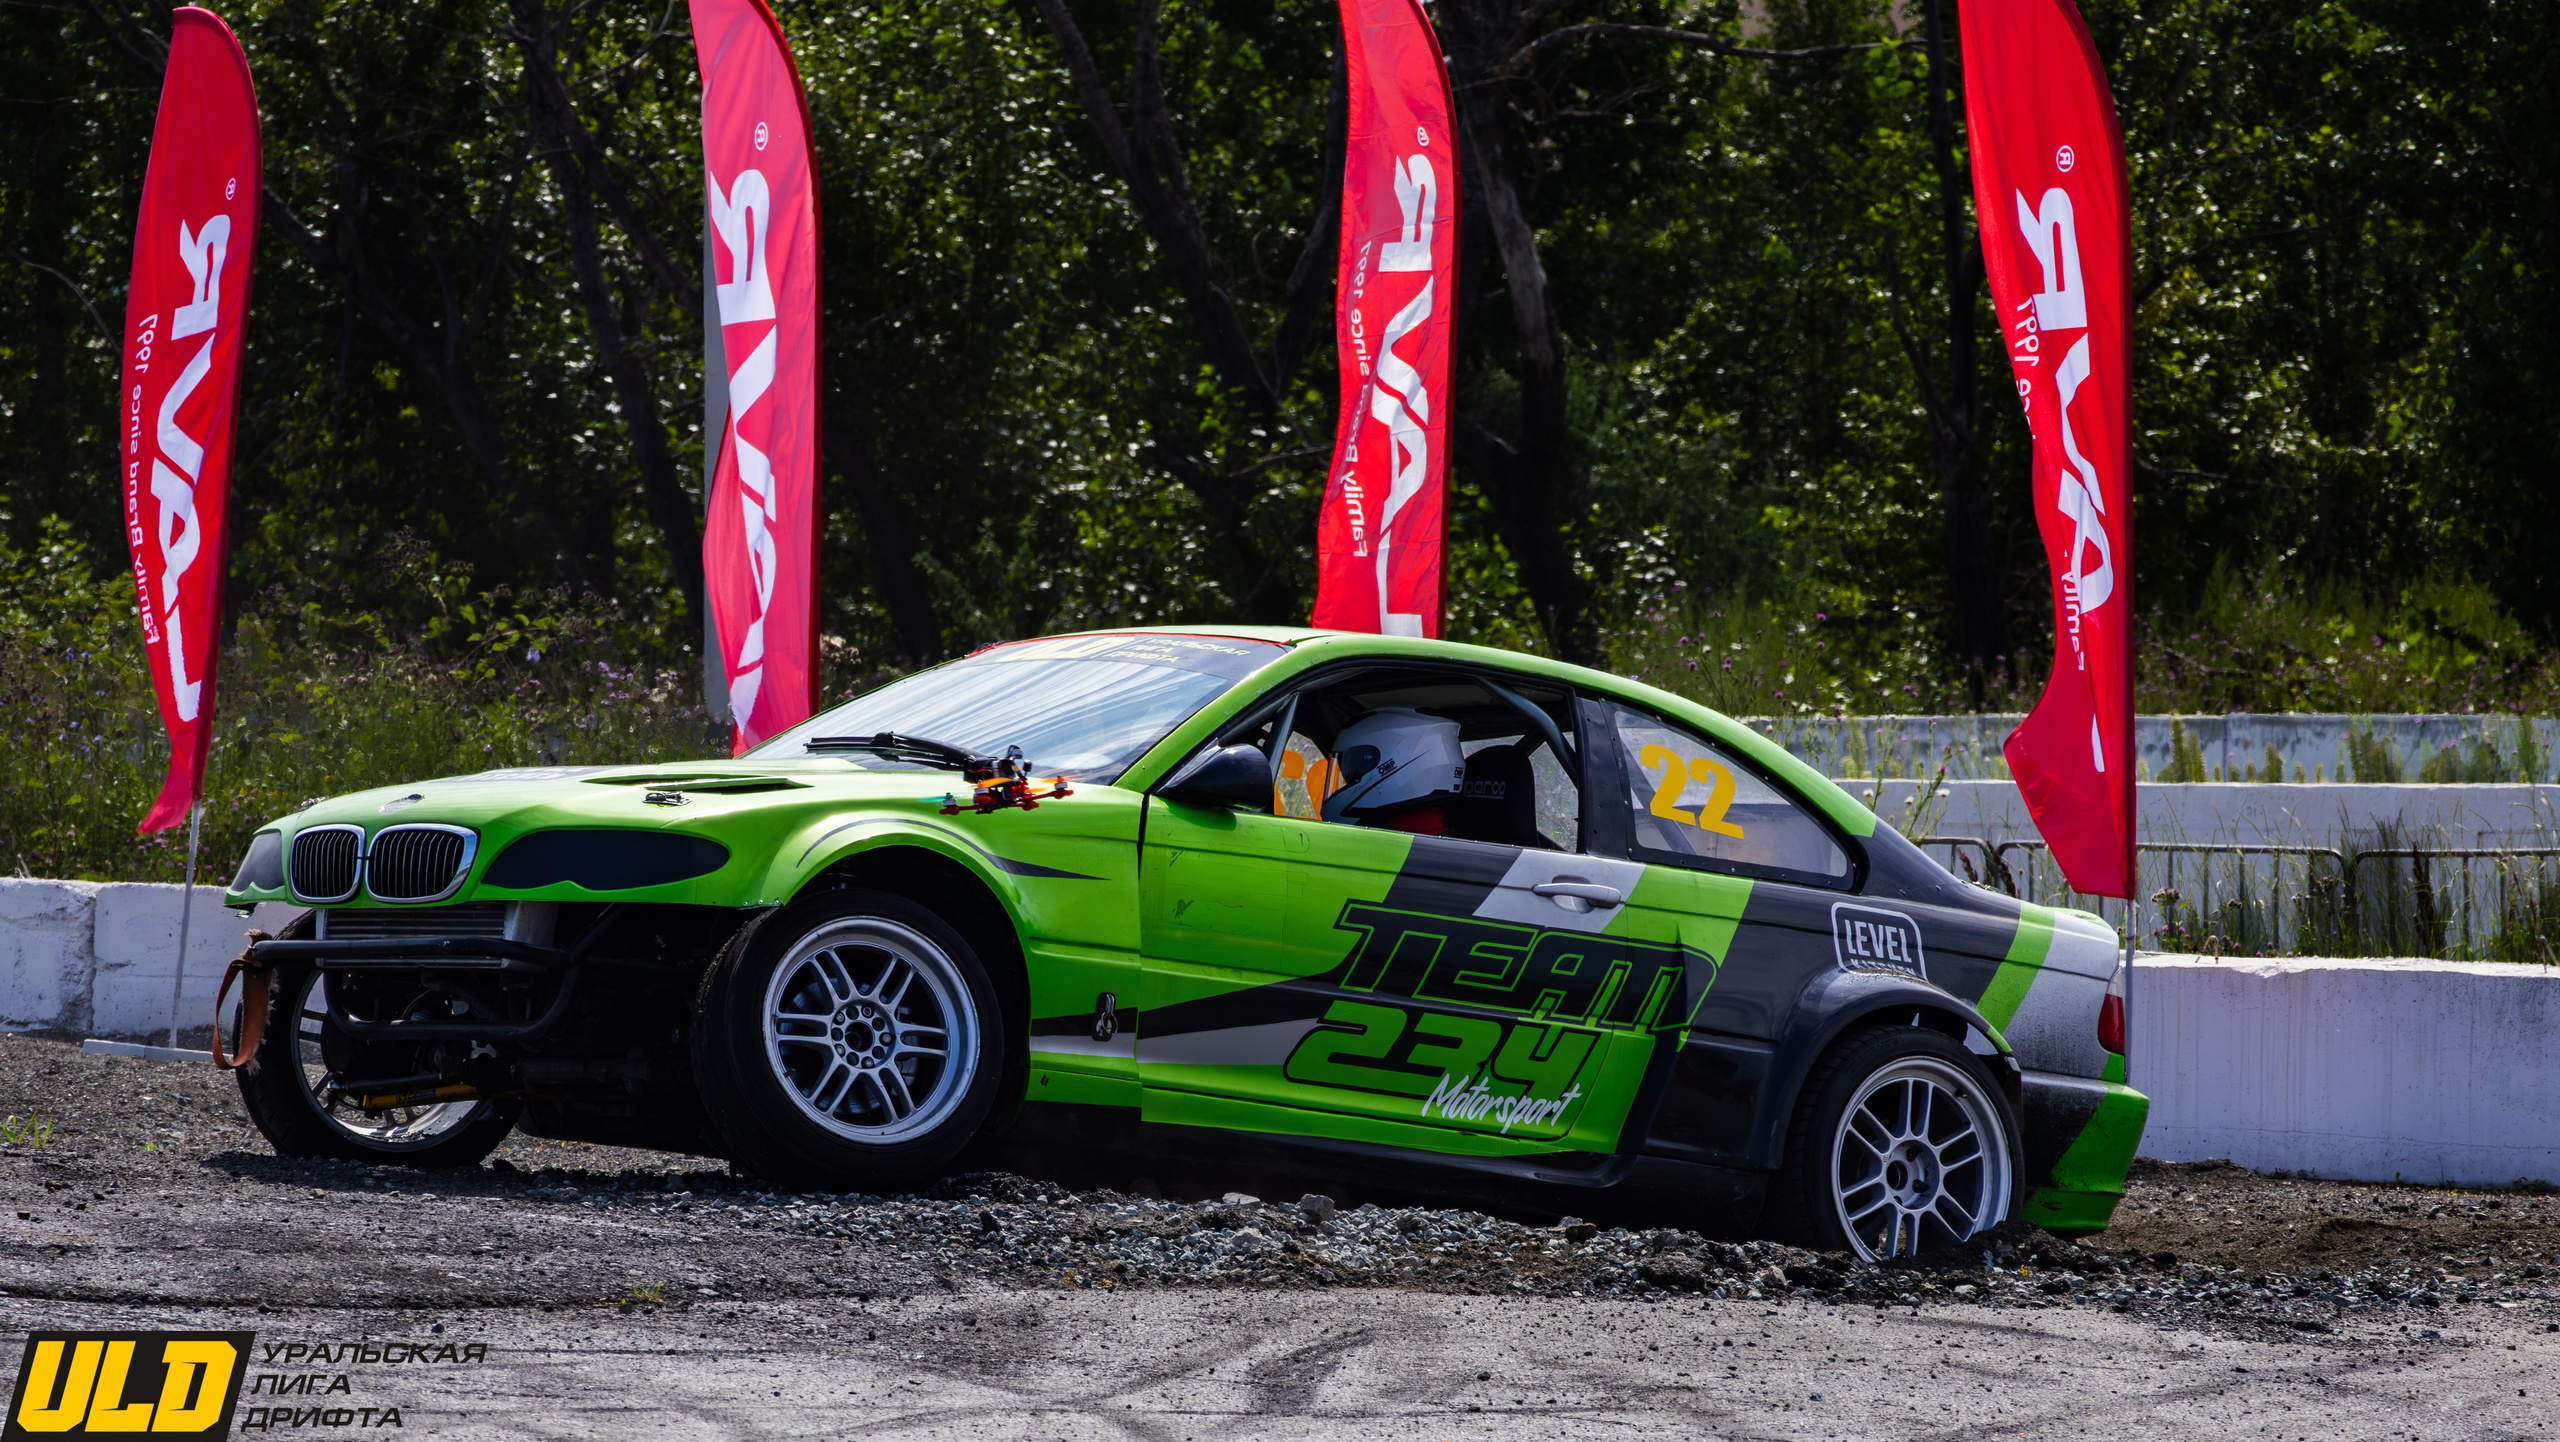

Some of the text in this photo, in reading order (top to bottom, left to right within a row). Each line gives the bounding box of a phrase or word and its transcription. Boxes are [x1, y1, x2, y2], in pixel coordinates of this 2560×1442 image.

[1378, 760, 1396, 775] OMP
[1463, 780, 1506, 795] parco
[1640, 743, 1745, 840] 22
[1335, 899, 1717, 1032] TEAM
[1844, 919, 1913, 963] LEVEL
[1283, 1000, 1600, 1117] 234
[1422, 1073, 1582, 1135] Motorsport
